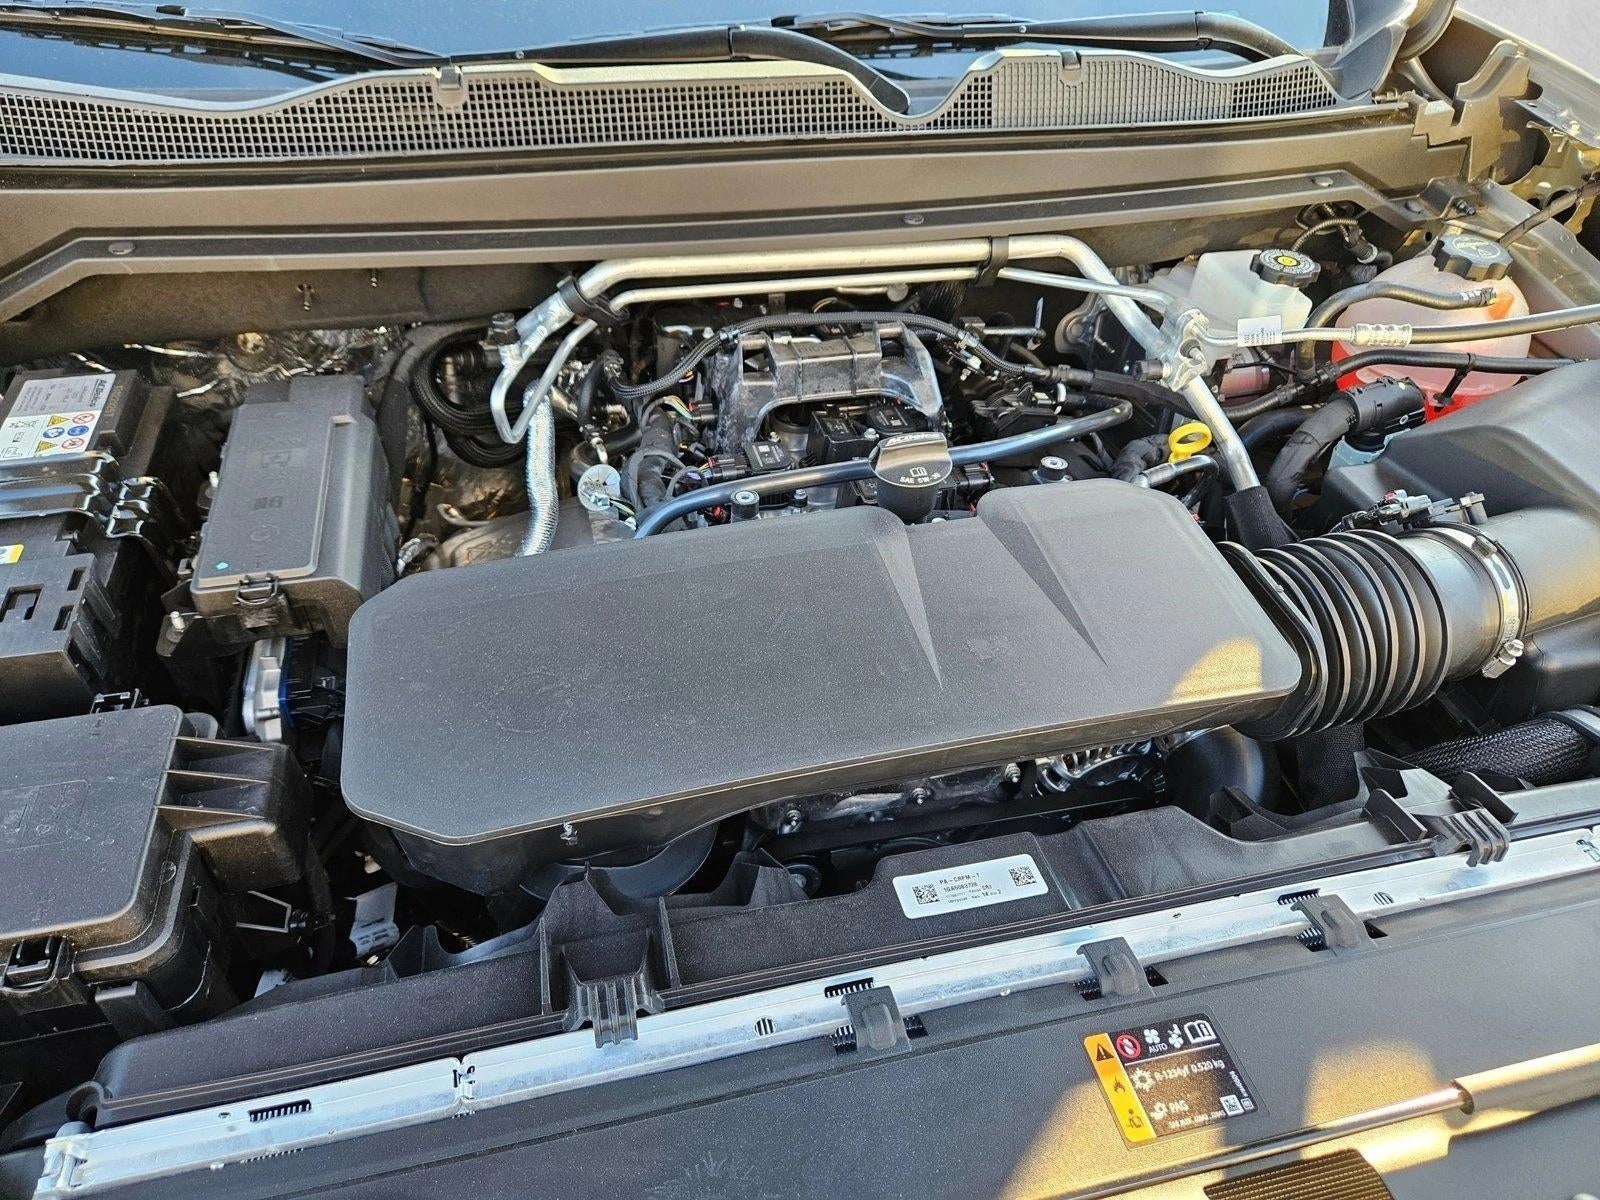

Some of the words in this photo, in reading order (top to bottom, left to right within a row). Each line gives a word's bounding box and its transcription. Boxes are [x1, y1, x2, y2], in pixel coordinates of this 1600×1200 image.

[89, 379, 107, 407] ACDelco
[885, 433, 941, 447] ACDelco
[899, 476, 915, 484] SAE
[1148, 1043, 1168, 1054] AUTO
[1191, 1060, 1213, 1073] 0.520
[1212, 1058, 1226, 1070] kg
[1168, 1100, 1189, 1113] PAG
